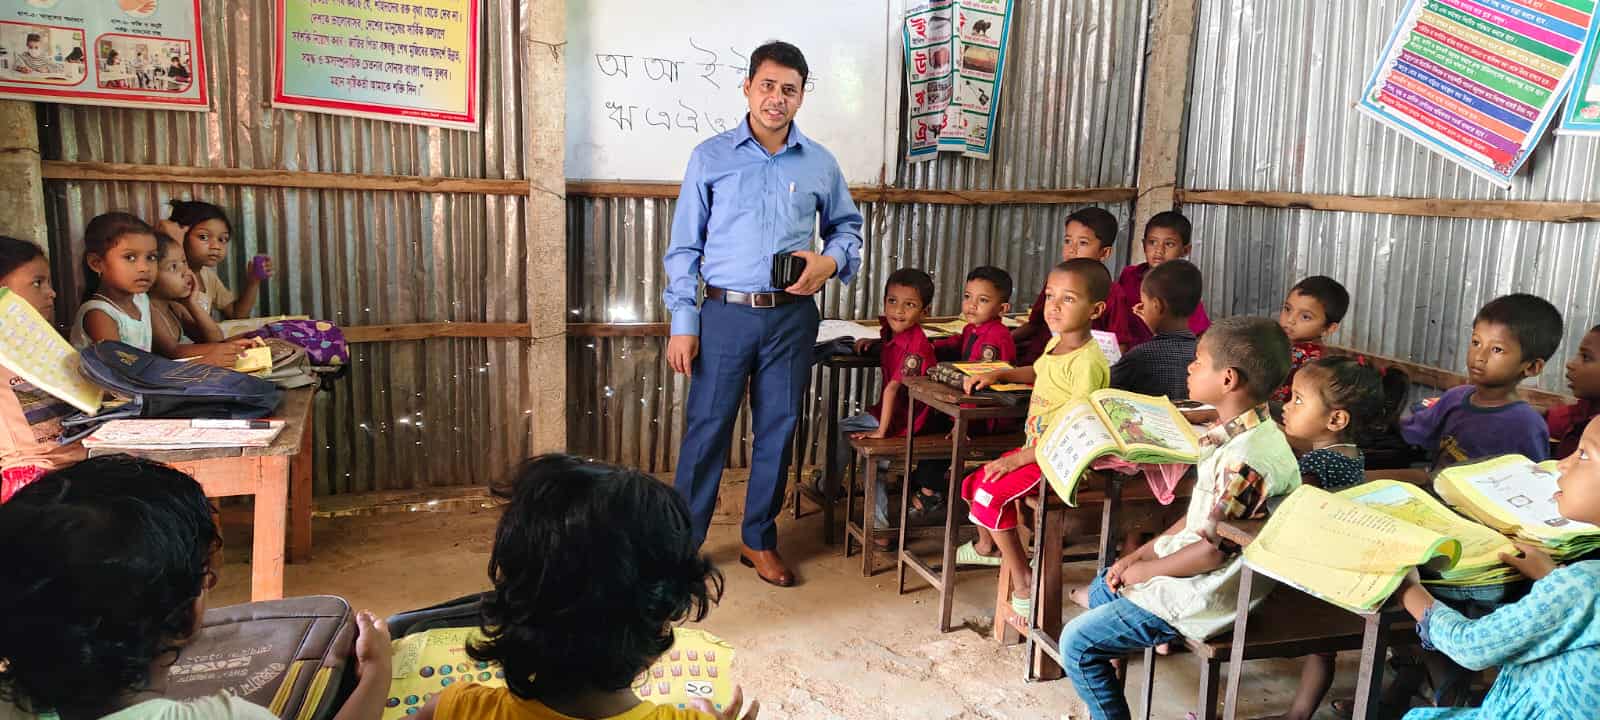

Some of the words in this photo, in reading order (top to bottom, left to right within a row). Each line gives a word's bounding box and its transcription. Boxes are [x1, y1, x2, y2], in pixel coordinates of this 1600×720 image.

[594, 53, 633, 79] অ
[642, 56, 685, 83] আ
[689, 36, 724, 89] ই
[645, 107, 671, 131] এ
